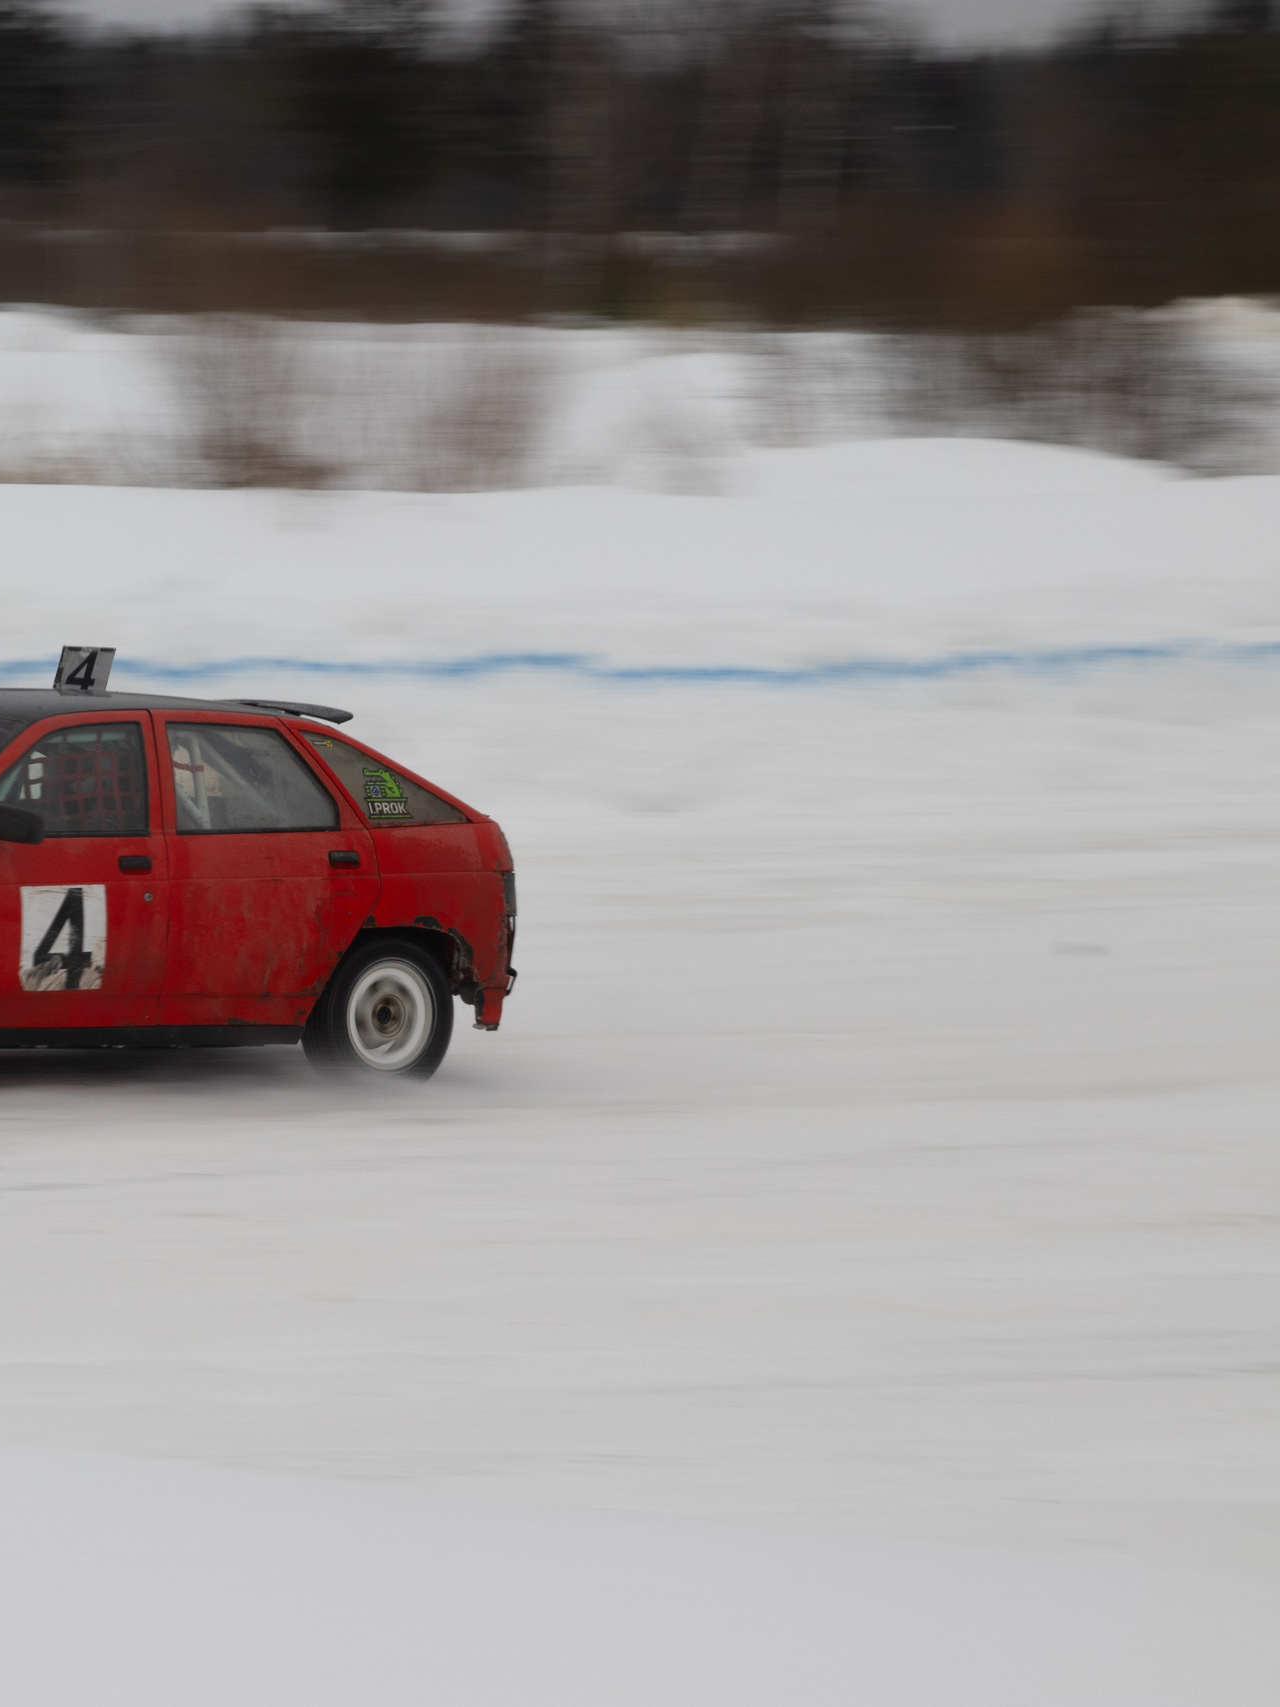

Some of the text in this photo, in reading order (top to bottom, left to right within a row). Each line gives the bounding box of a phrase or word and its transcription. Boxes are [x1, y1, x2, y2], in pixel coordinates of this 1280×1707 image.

[65, 650, 99, 690] 4
[368, 802, 408, 814] I.PROK
[33, 888, 93, 989] 4
